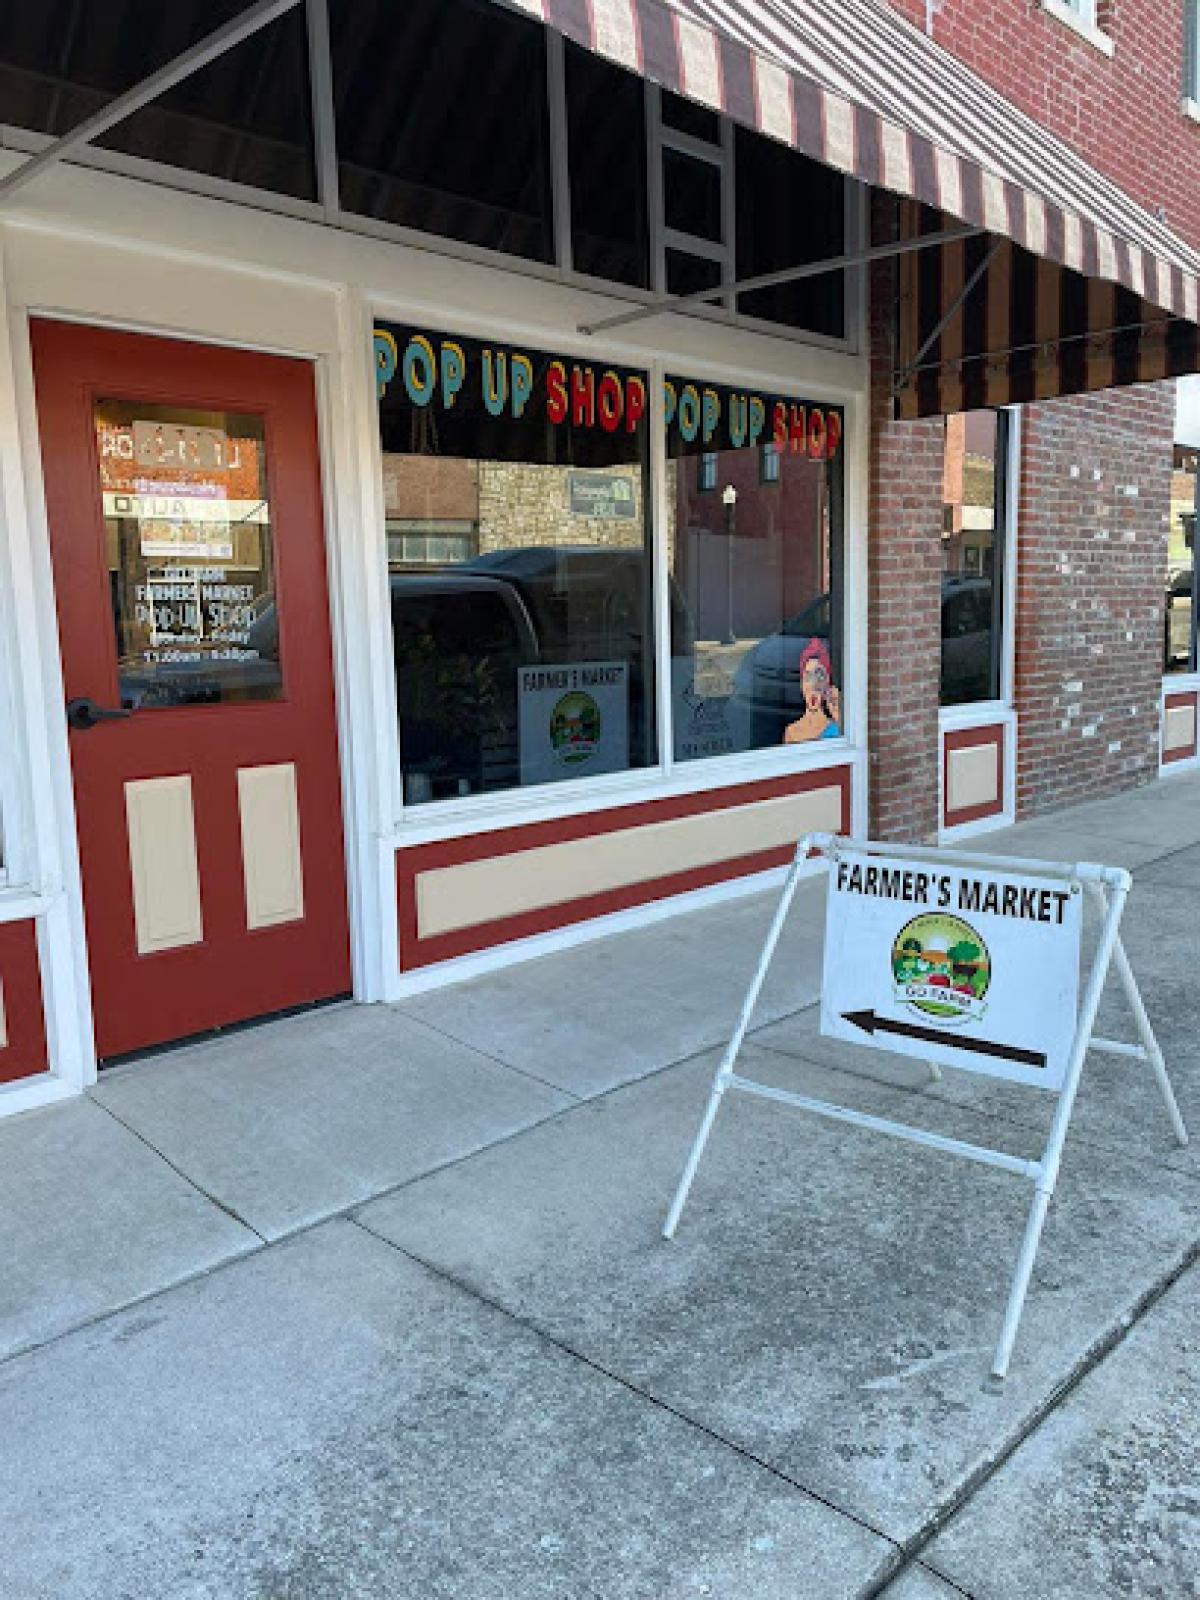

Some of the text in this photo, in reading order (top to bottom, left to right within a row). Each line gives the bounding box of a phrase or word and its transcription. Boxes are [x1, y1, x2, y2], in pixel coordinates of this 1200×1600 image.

[373, 328, 645, 433] POP UP SHOP
[729, 393, 765, 448] UP
[773, 400, 842, 460] SHOP
[581, 667, 625, 686] MARKET
[837, 863, 1071, 924] FARMER'S MARKET
